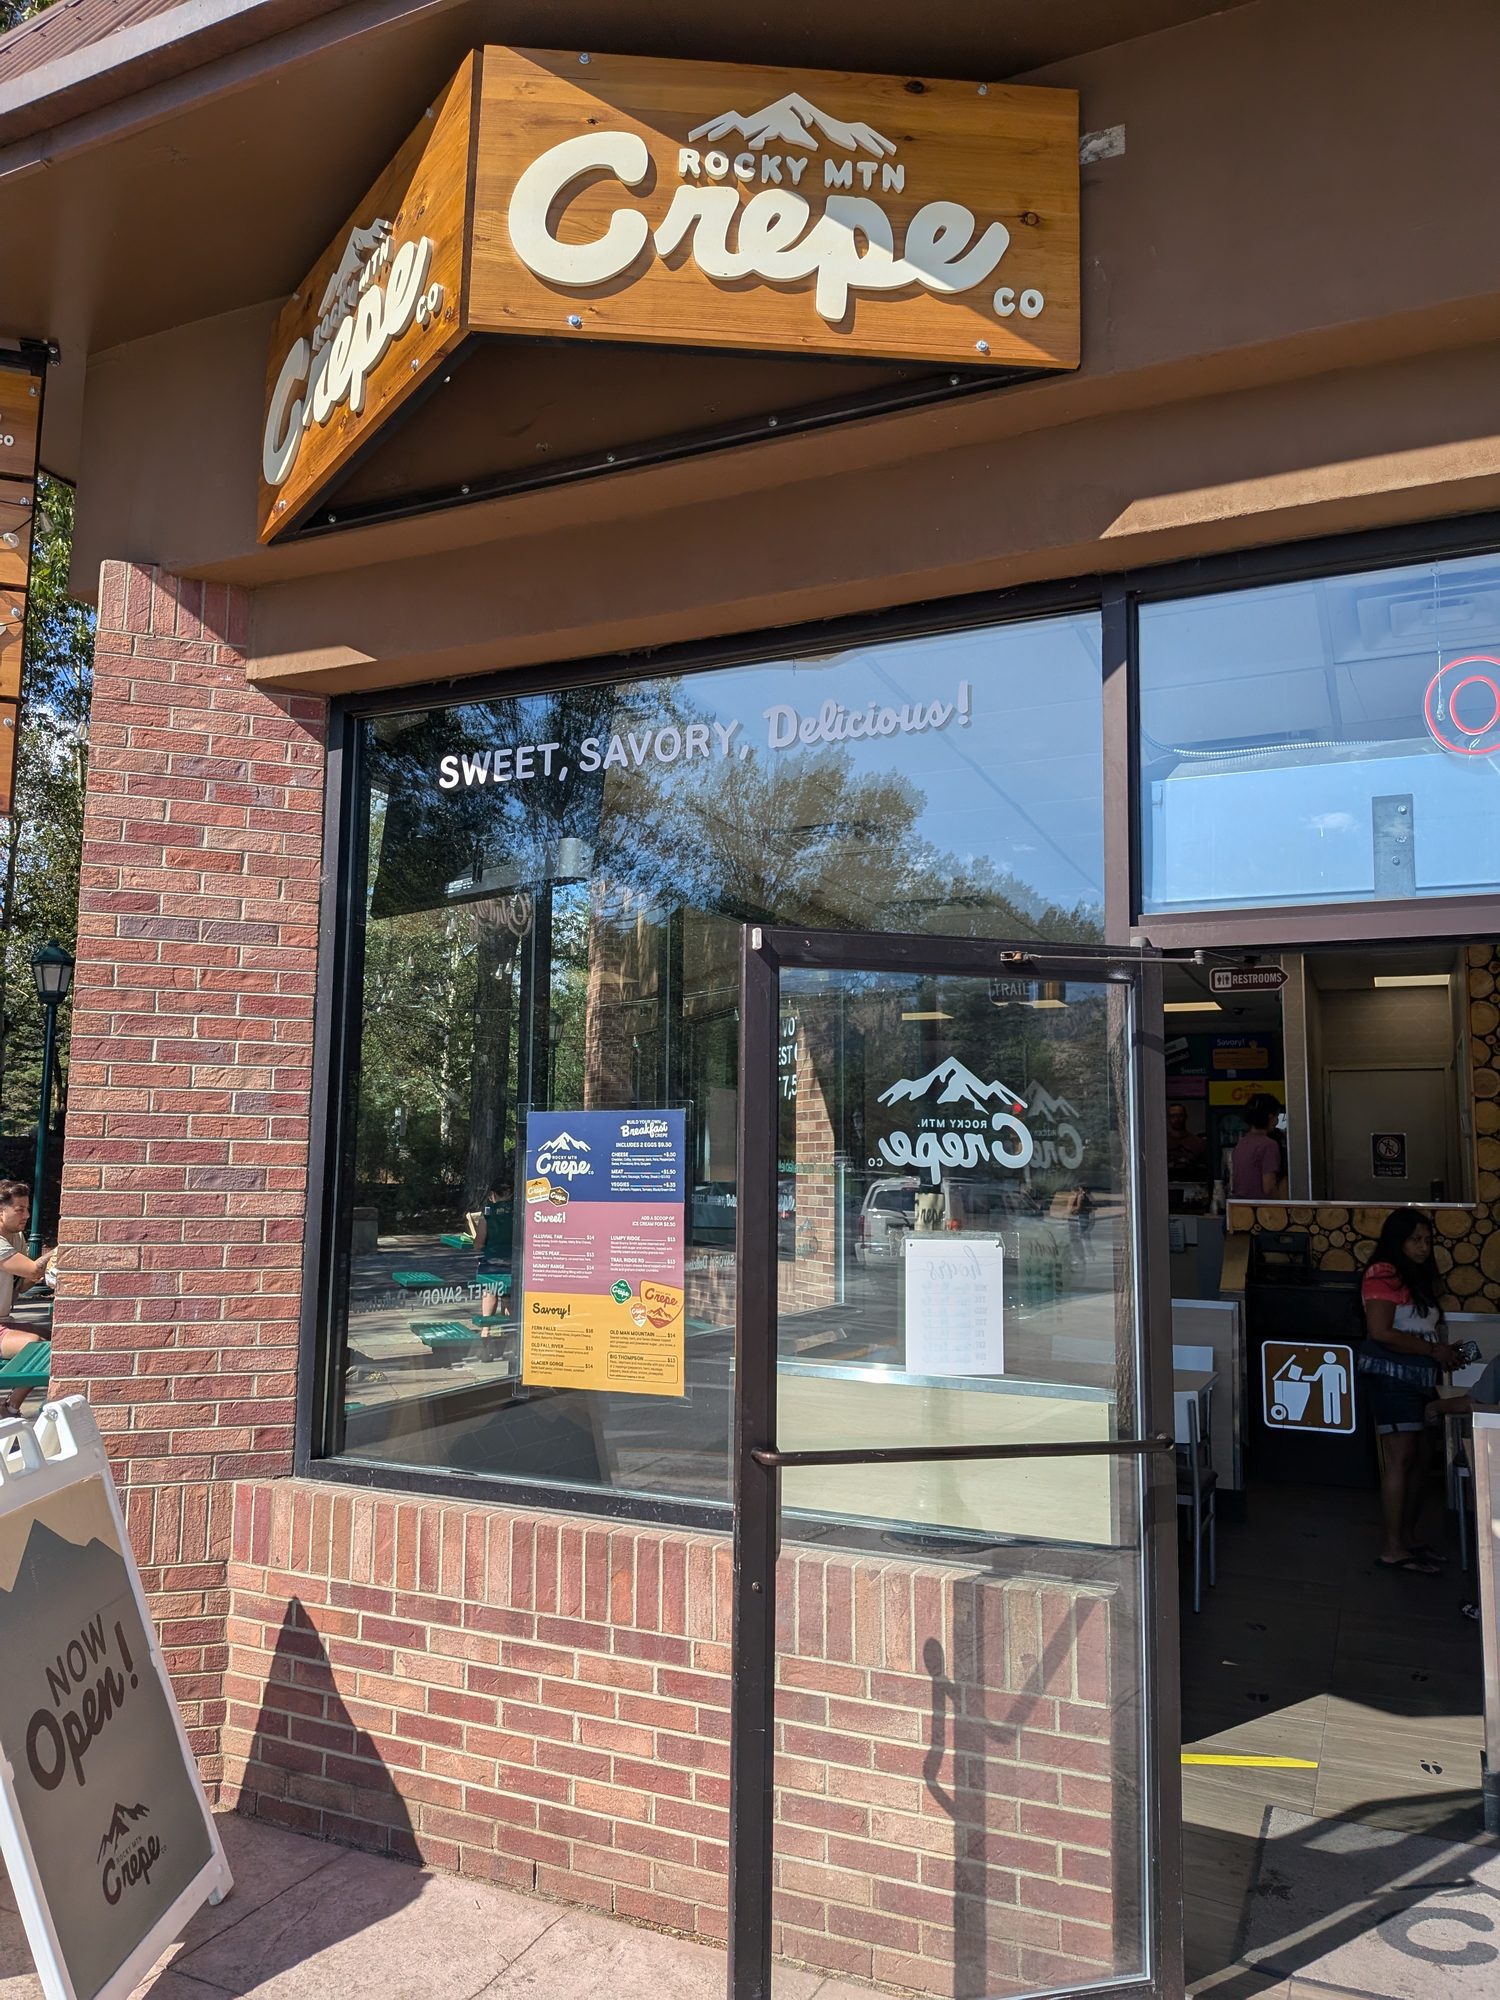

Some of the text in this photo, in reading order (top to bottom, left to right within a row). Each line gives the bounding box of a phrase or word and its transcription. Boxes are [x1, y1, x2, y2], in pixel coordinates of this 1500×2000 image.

[678, 148, 906, 195] ROCKY MTN
[508, 131, 1010, 322] Crepe
[358, 235, 394, 292] MTN
[416, 282, 445, 326] CO
[992, 286, 1045, 320] CO
[263, 235, 433, 486] Crepe
[438, 679, 971, 789] SWEET, SAVORY, Delicious!
[1232, 973, 1282, 985] RESTROOMS
[620, 1121, 668, 1138] Breakfast
[536, 1152, 591, 1181] Crepe
[533, 1211, 566, 1224] Sweet!
[532, 1302, 571, 1320] Savory!
[645, 1287, 678, 1308] Crepe
[45, 1613, 107, 1707] NOW
[25, 1620, 140, 1792] Open!
[102, 1835, 161, 1906] Crepe
